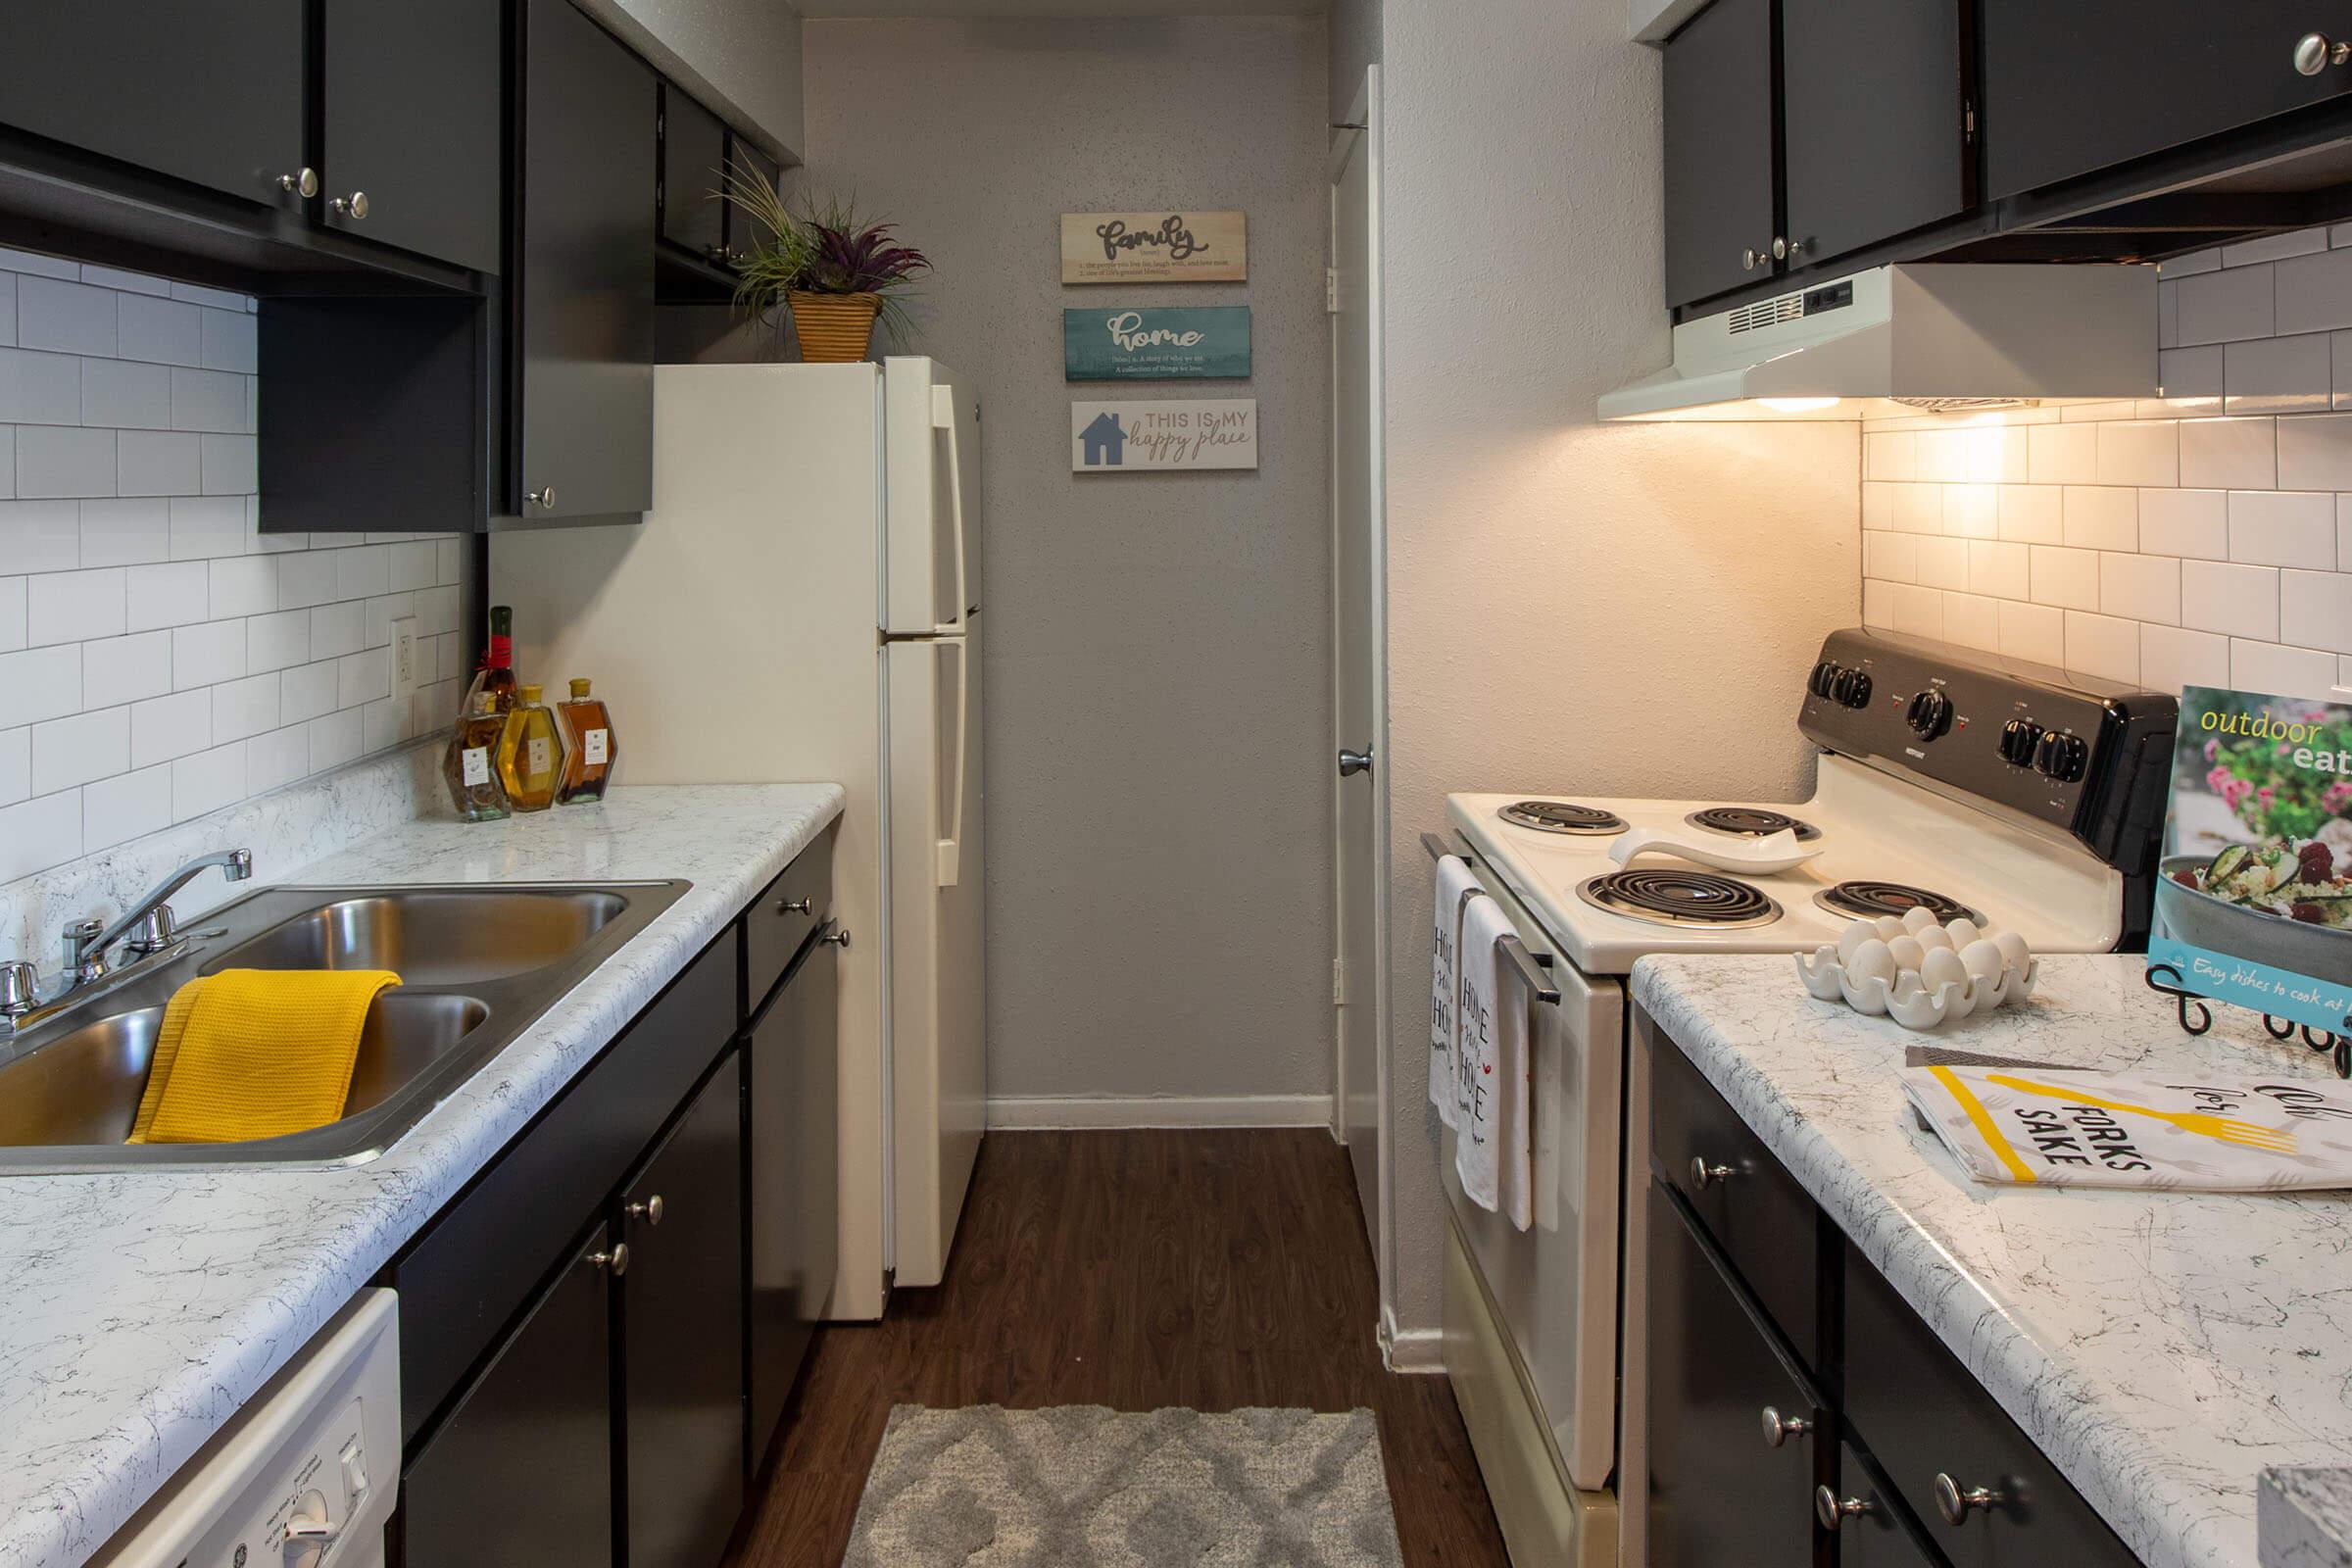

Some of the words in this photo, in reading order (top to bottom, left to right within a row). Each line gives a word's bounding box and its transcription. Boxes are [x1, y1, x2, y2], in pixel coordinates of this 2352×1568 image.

[1096, 215, 1209, 261] family
[1106, 312, 1205, 352] home
[1129, 420, 1192, 463] happy
[1192, 418, 1252, 461] place
[1145, 413, 1189, 428] THIS
[1197, 412, 1214, 427] IS
[1222, 412, 1248, 427] MY
[2200, 710, 2323, 745] outdoor
[2292, 747, 2352, 776] eat
[2192, 957, 2227, 986] Easy
[2230, 963, 2271, 993] dishes
[2274, 981, 2285, 997] to
[2290, 988, 2321, 1005] cook
[2325, 997, 2344, 1011] at
[1460, 1051, 1488, 1122] HOE
[2014, 1108, 2093, 1166] SAKE
[2061, 1106, 2152, 1171] FORKS
